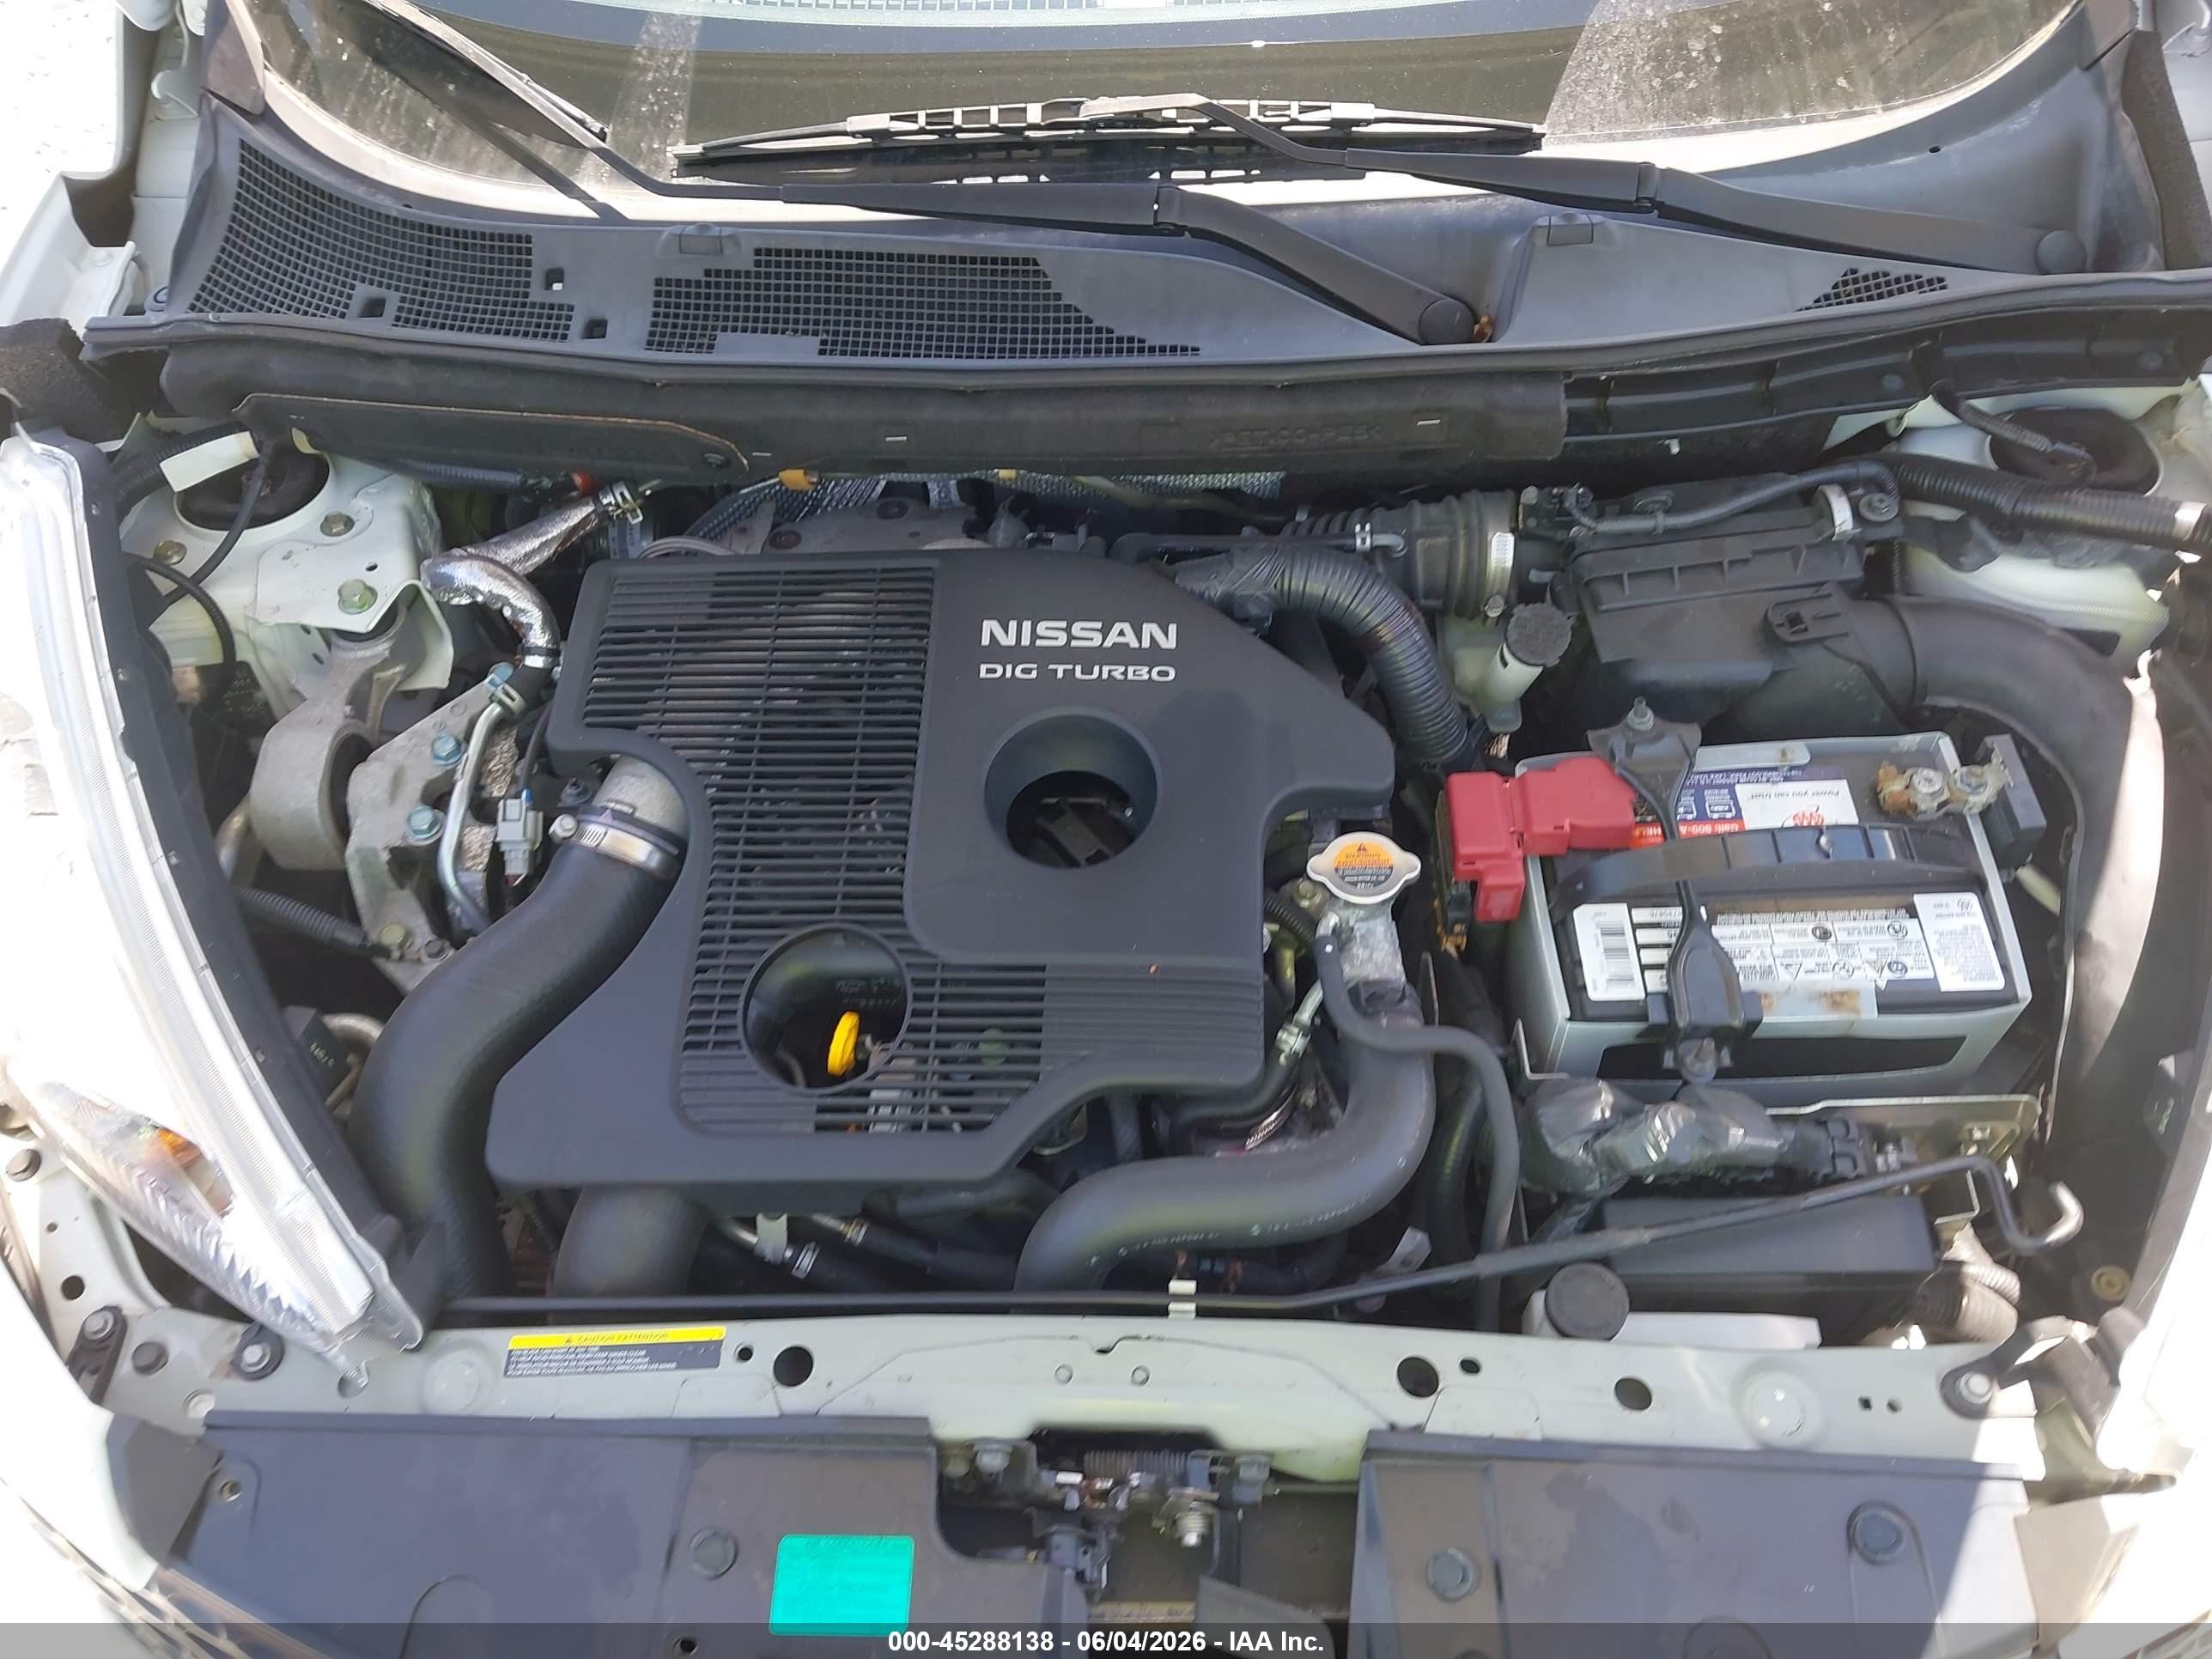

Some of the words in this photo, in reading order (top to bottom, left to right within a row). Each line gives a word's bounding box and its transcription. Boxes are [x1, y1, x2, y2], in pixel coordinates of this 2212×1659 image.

[981, 618, 1178, 650] NISSAN
[979, 663, 1038, 680] DIG
[1047, 663, 1177, 682] TURBO
